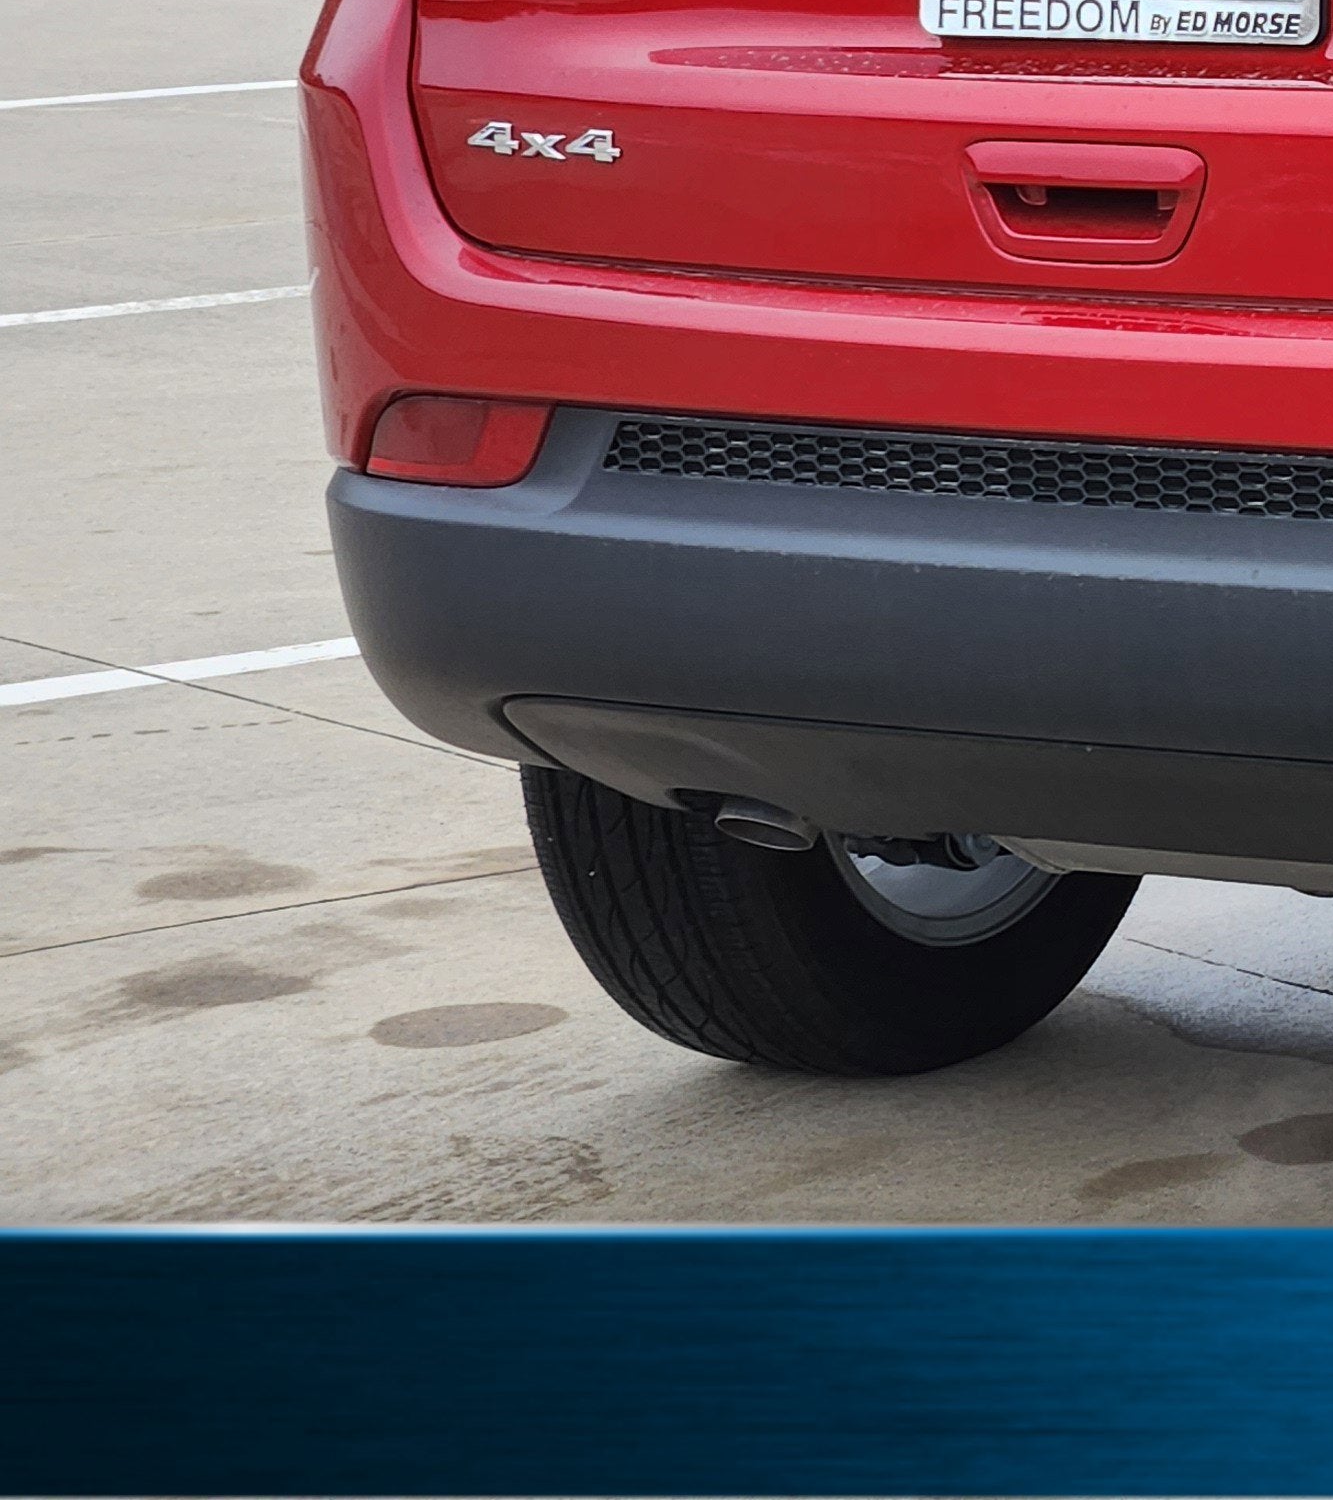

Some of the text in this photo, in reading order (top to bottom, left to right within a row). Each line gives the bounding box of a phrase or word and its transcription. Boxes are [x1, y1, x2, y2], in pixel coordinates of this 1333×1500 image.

[1176, 10, 1207, 33] ED
[1211, 11, 1301, 36] MORSE
[467, 120, 622, 163] 4x4
